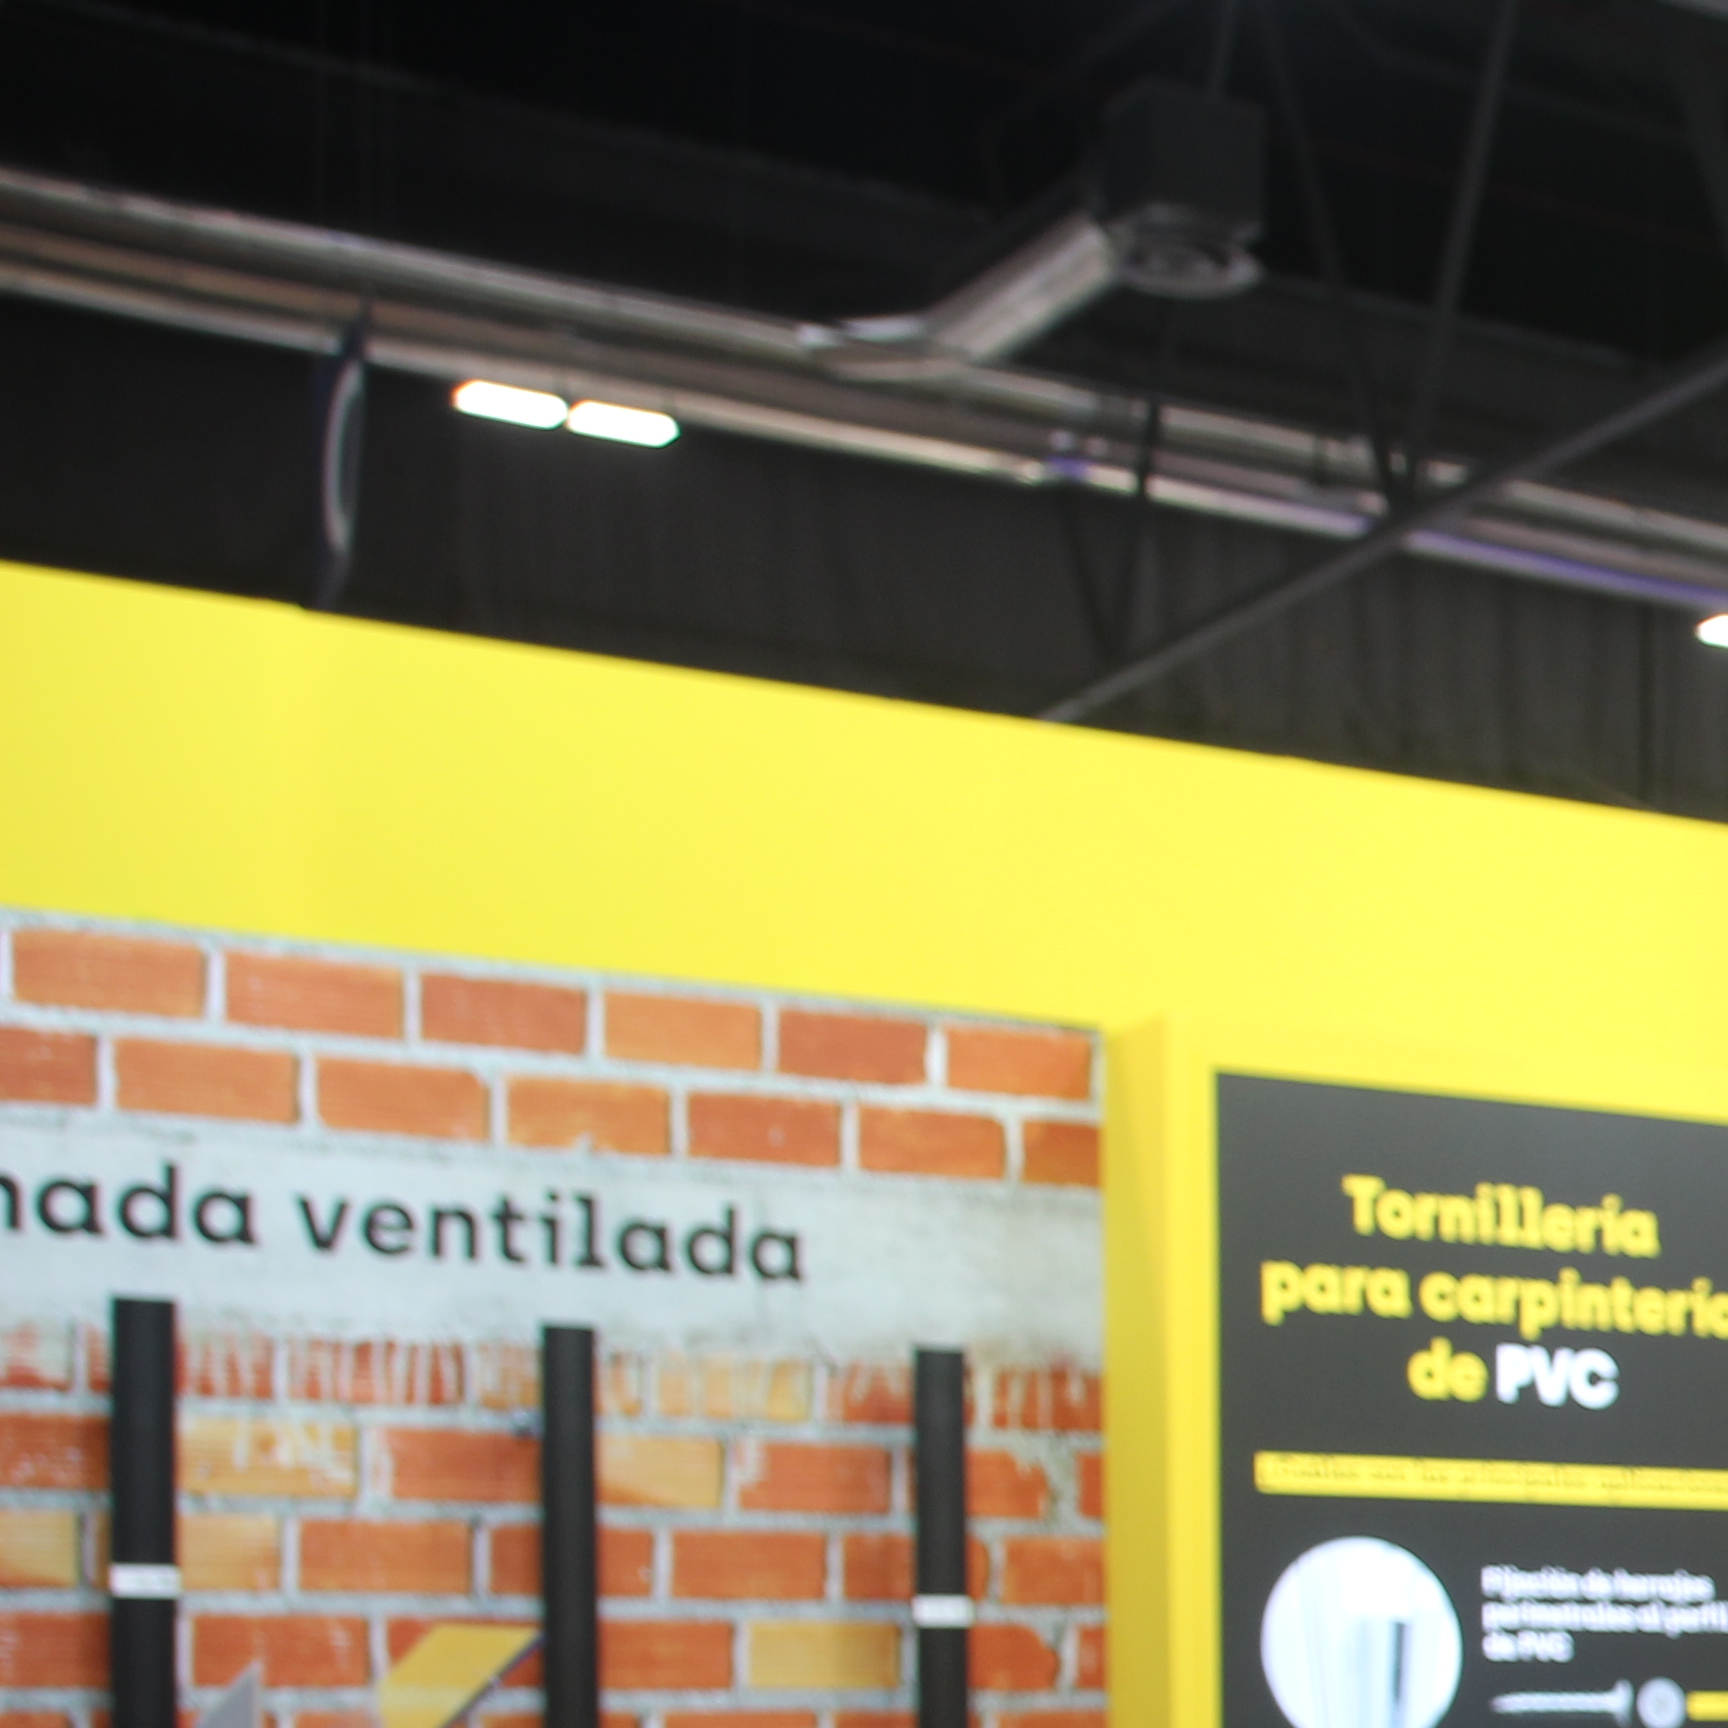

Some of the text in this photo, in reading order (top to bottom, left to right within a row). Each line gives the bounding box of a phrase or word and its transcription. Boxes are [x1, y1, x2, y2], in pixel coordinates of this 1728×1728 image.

[299, 1191, 803, 1282] ventilada
[1260, 1259, 1413, 1326] para
[1407, 1336, 1619, 1409] de PVC
